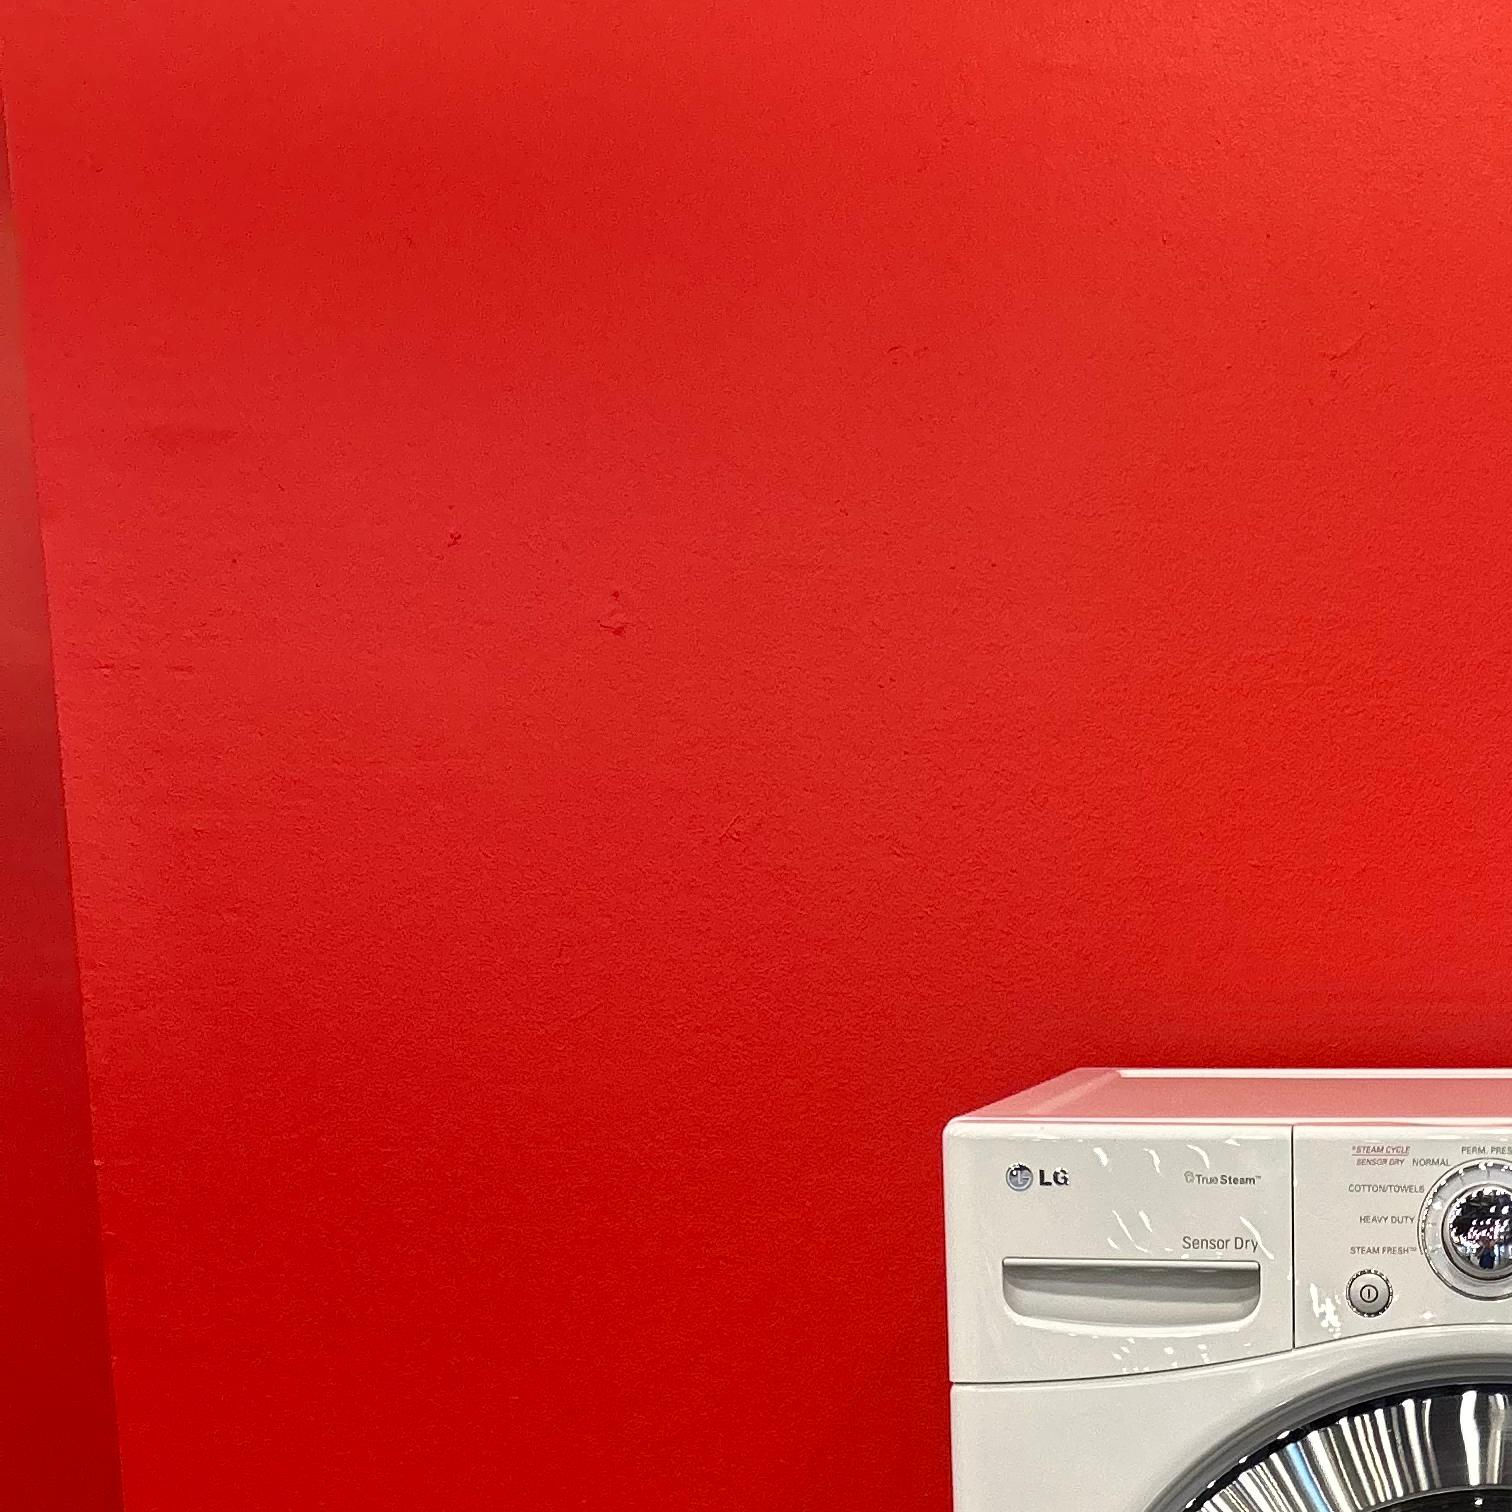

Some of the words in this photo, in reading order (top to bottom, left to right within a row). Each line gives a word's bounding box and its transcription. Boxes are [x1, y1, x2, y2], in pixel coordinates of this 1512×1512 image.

[1388, 1158, 1405, 1166] DRY
[1412, 1158, 1450, 1167] NORMAL
[1359, 1215, 1389, 1224] HEAVY
[1390, 1215, 1416, 1224] DUTY
[1182, 1235, 1231, 1250] Sensor
[1234, 1236, 1259, 1253] Dry
[1350, 1246, 1380, 1255] STEAM
